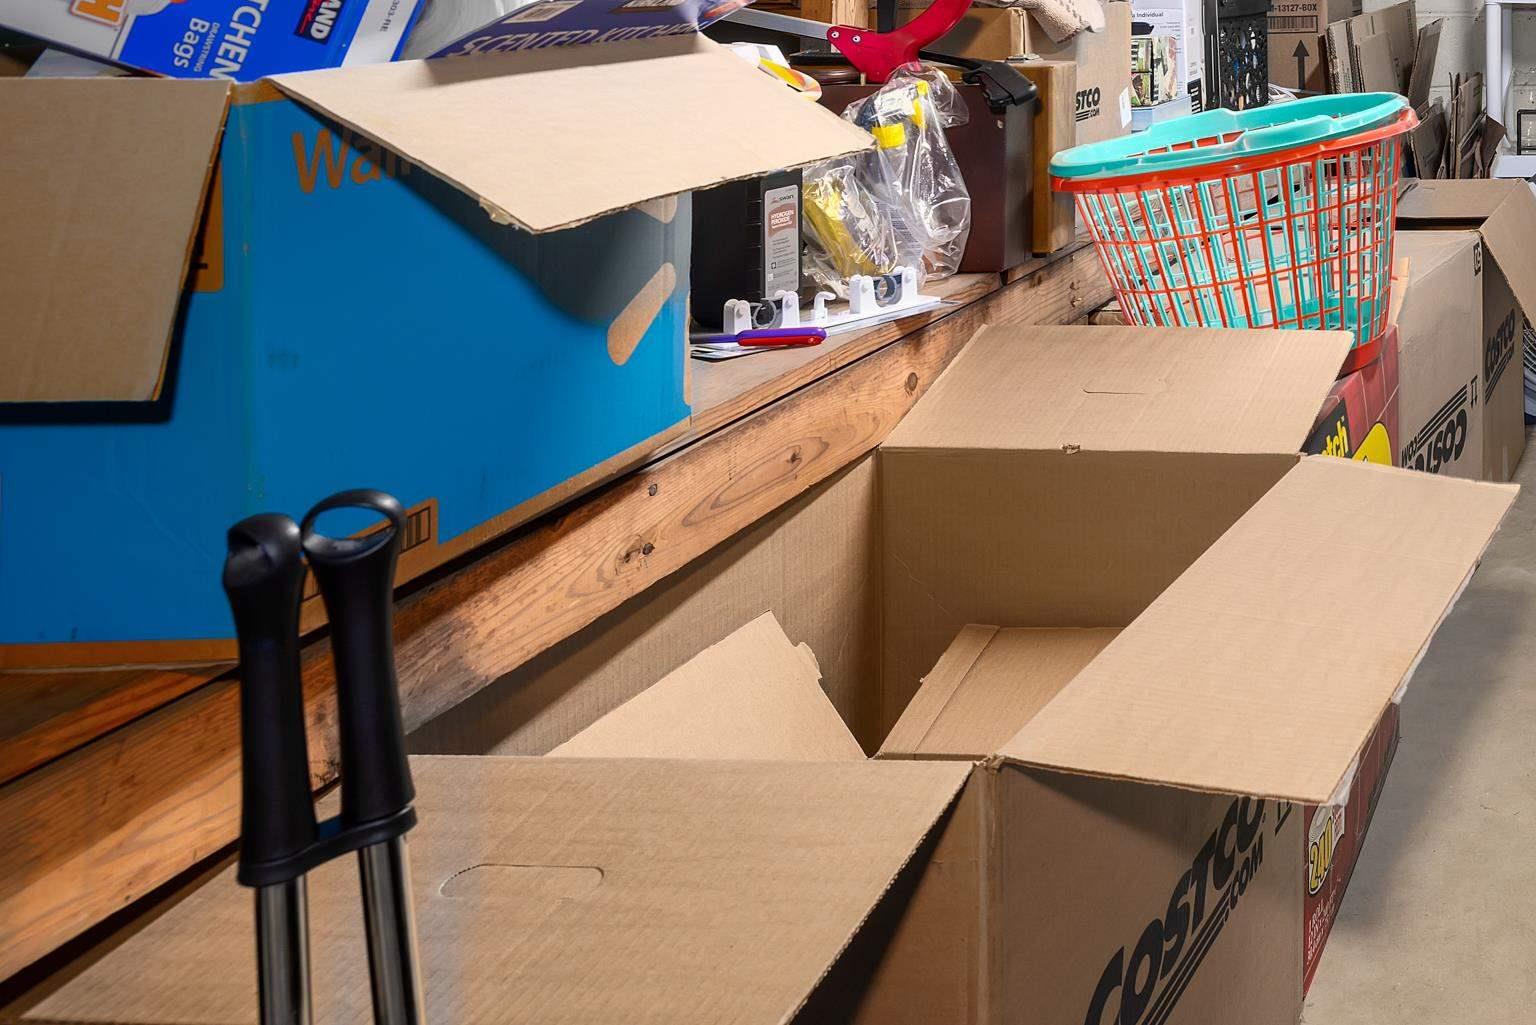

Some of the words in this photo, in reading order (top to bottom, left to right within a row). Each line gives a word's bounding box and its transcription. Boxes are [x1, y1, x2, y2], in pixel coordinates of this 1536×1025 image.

[173, 17, 211, 69] Bags
[1076, 86, 1101, 112] STCO
[1484, 307, 1515, 383] COSTCO
[1309, 815, 1333, 893] 240
